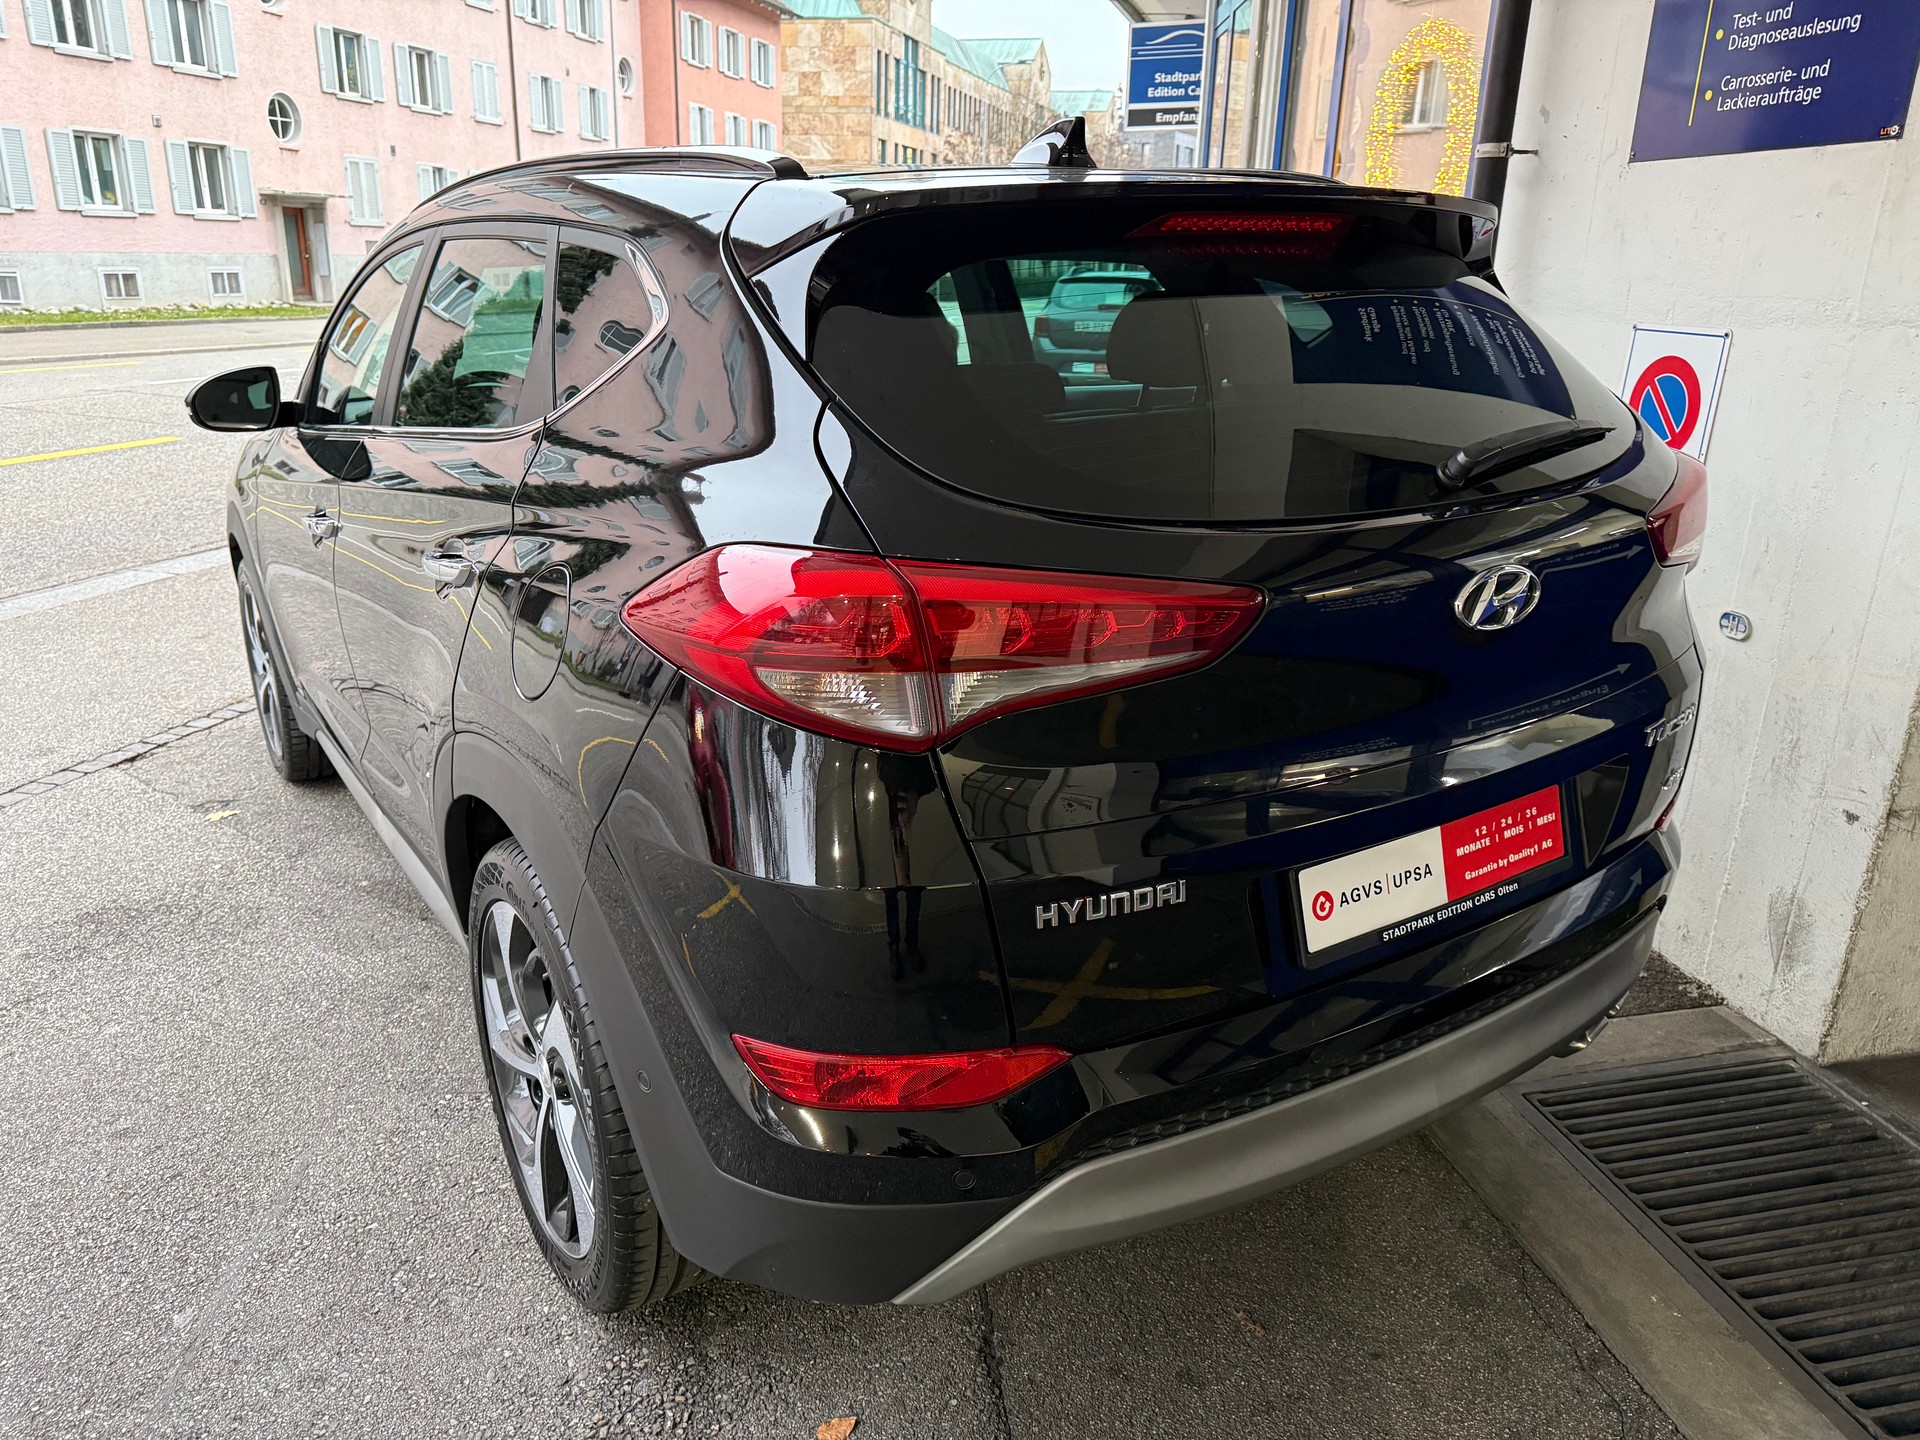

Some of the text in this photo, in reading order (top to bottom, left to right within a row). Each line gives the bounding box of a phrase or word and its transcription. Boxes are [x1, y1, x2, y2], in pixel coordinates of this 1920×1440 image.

[1728, 13, 1862, 51] Diagnoseauslesung
[1732, 1, 1794, 30] Test- und
[1147, 86, 1185, 98] Edition
[1721, 59, 1831, 91] Carrosserie- und
[1717, 84, 1822, 112] Lackieraufträge
[1456, 837, 1491, 857] MONATE
[1503, 825, 1524, 839] MOIS
[1536, 812, 1556, 826] MESI
[1475, 825, 1487, 837] 12
[1501, 816, 1513, 828] 24
[1525, 807, 1537, 818] 36
[1465, 839, 1553, 880] Garantie by Quality1 AG
[1035, 879, 1187, 930] HYUNDAI
[1339, 880, 1383, 908] AGVS
[1392, 863, 1433, 888] UPSA
[1382, 882, 1519, 942] STADTPARK EDITION CARS Olten
